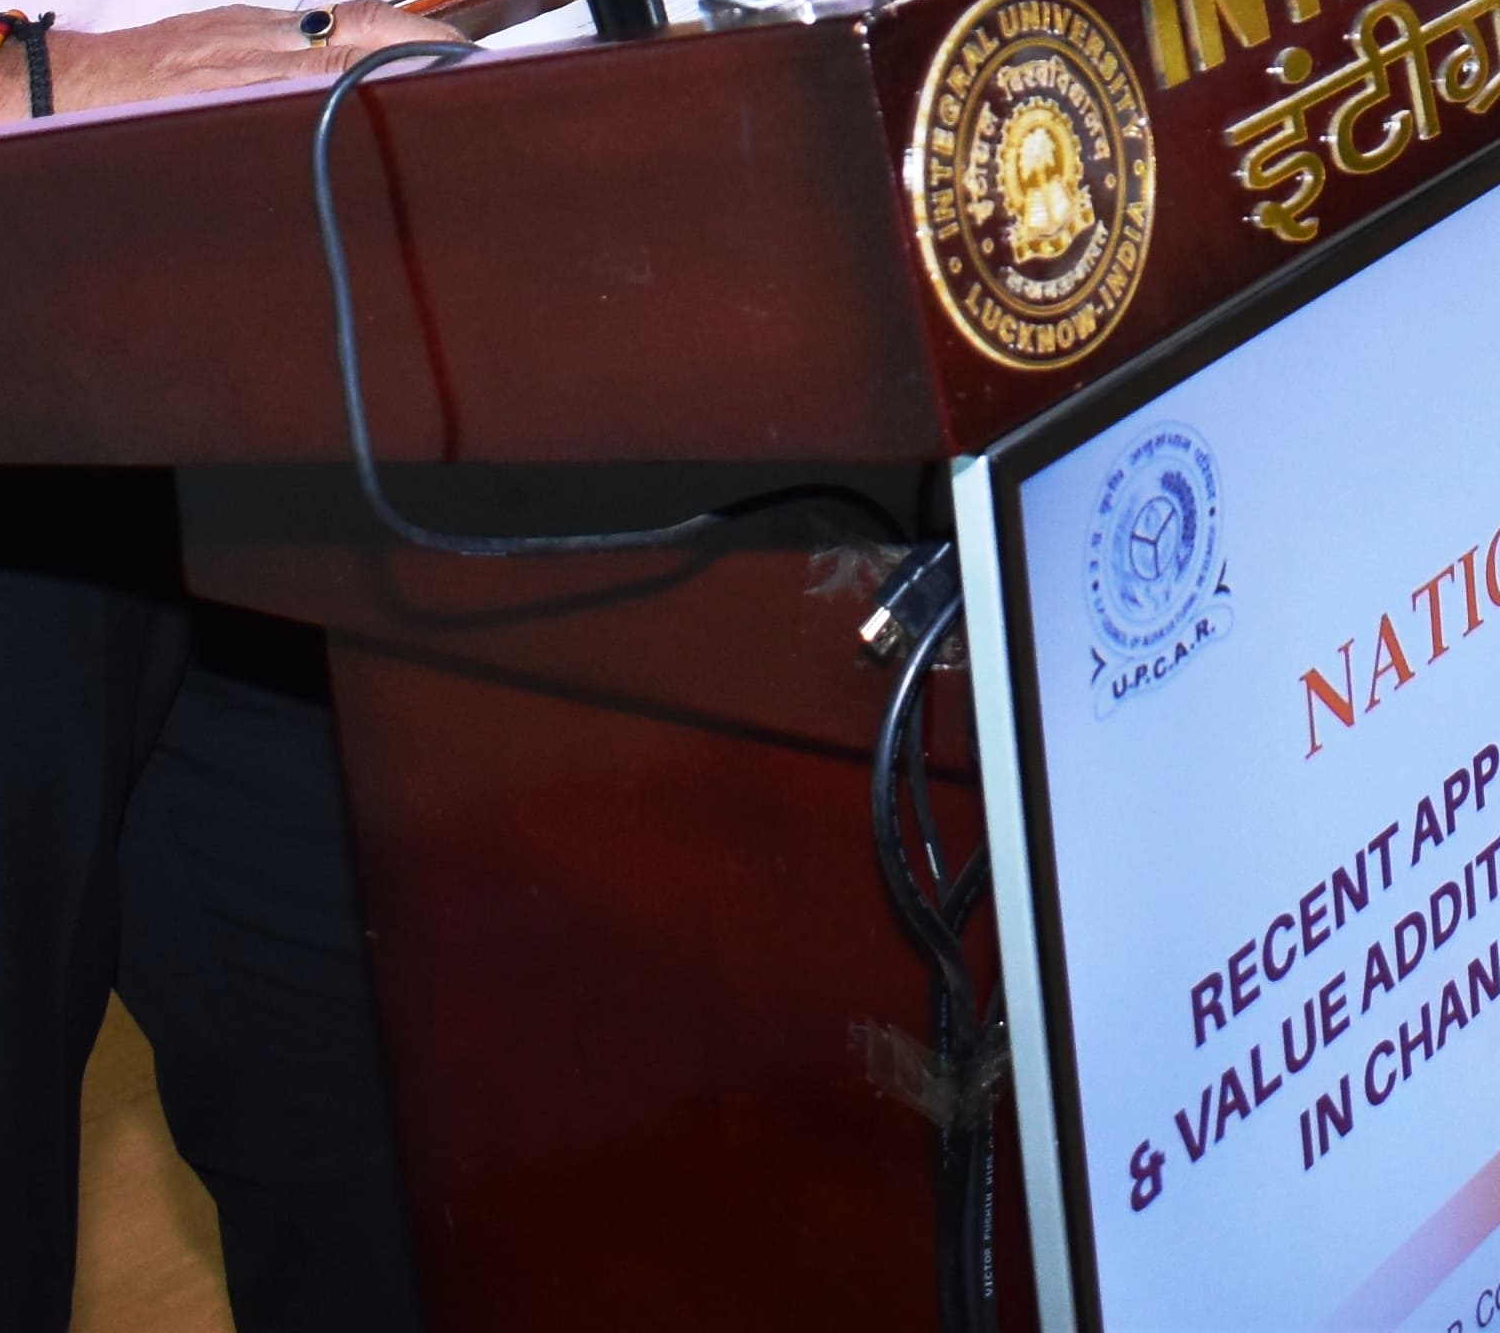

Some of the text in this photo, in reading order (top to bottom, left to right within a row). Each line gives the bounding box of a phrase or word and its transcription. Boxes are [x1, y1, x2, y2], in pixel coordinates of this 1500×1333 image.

[930, 0, 1150, 240] INTEGRAL UNIVERSITY
[1111, 618, 1216, 699] U.P.C.A.R.
[1190, 821, 1400, 1048] RECENT
[1129, 1139, 1166, 1212] &
[1174, 971, 1351, 1163] VALUE
[1300, 1076, 1354, 1172] IN
